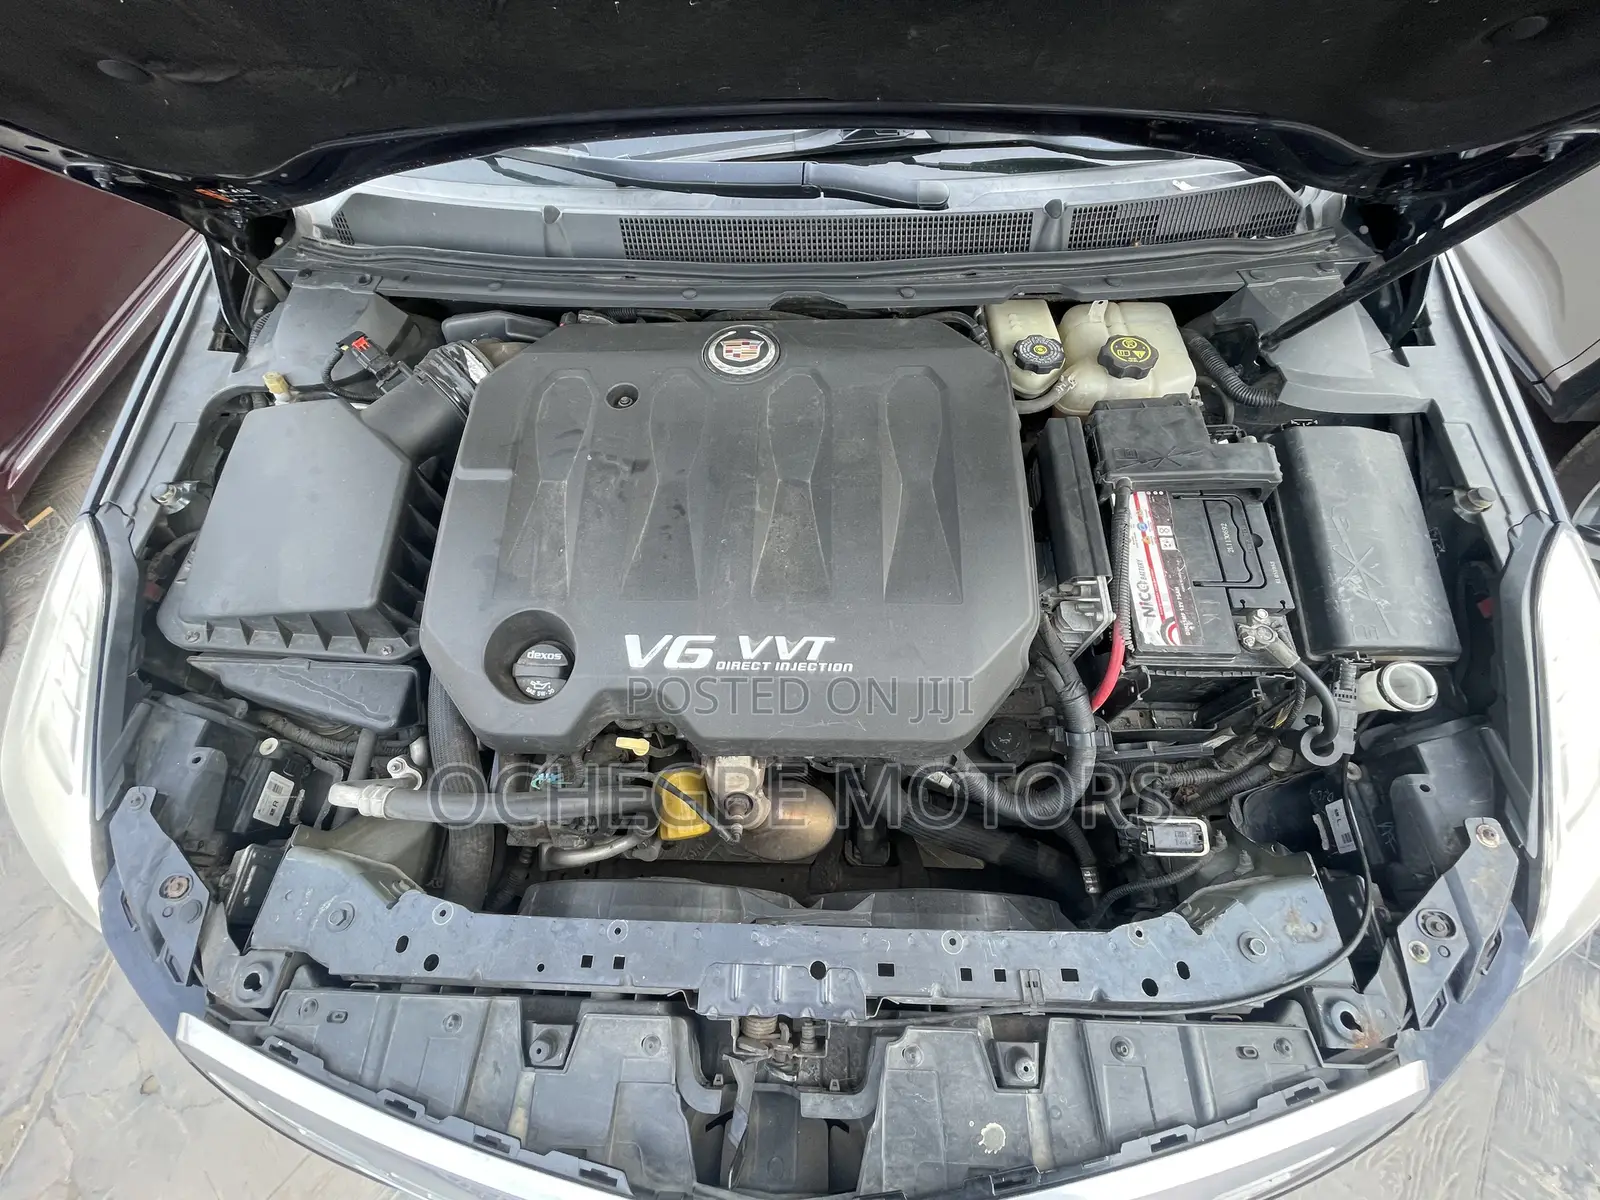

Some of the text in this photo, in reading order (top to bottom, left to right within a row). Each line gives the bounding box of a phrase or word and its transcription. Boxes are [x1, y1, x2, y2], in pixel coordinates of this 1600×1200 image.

[527, 650, 563, 660] dexos
[624, 634, 836, 669] V6 VVT
[715, 661, 854, 673] DIRECT INJECTION
